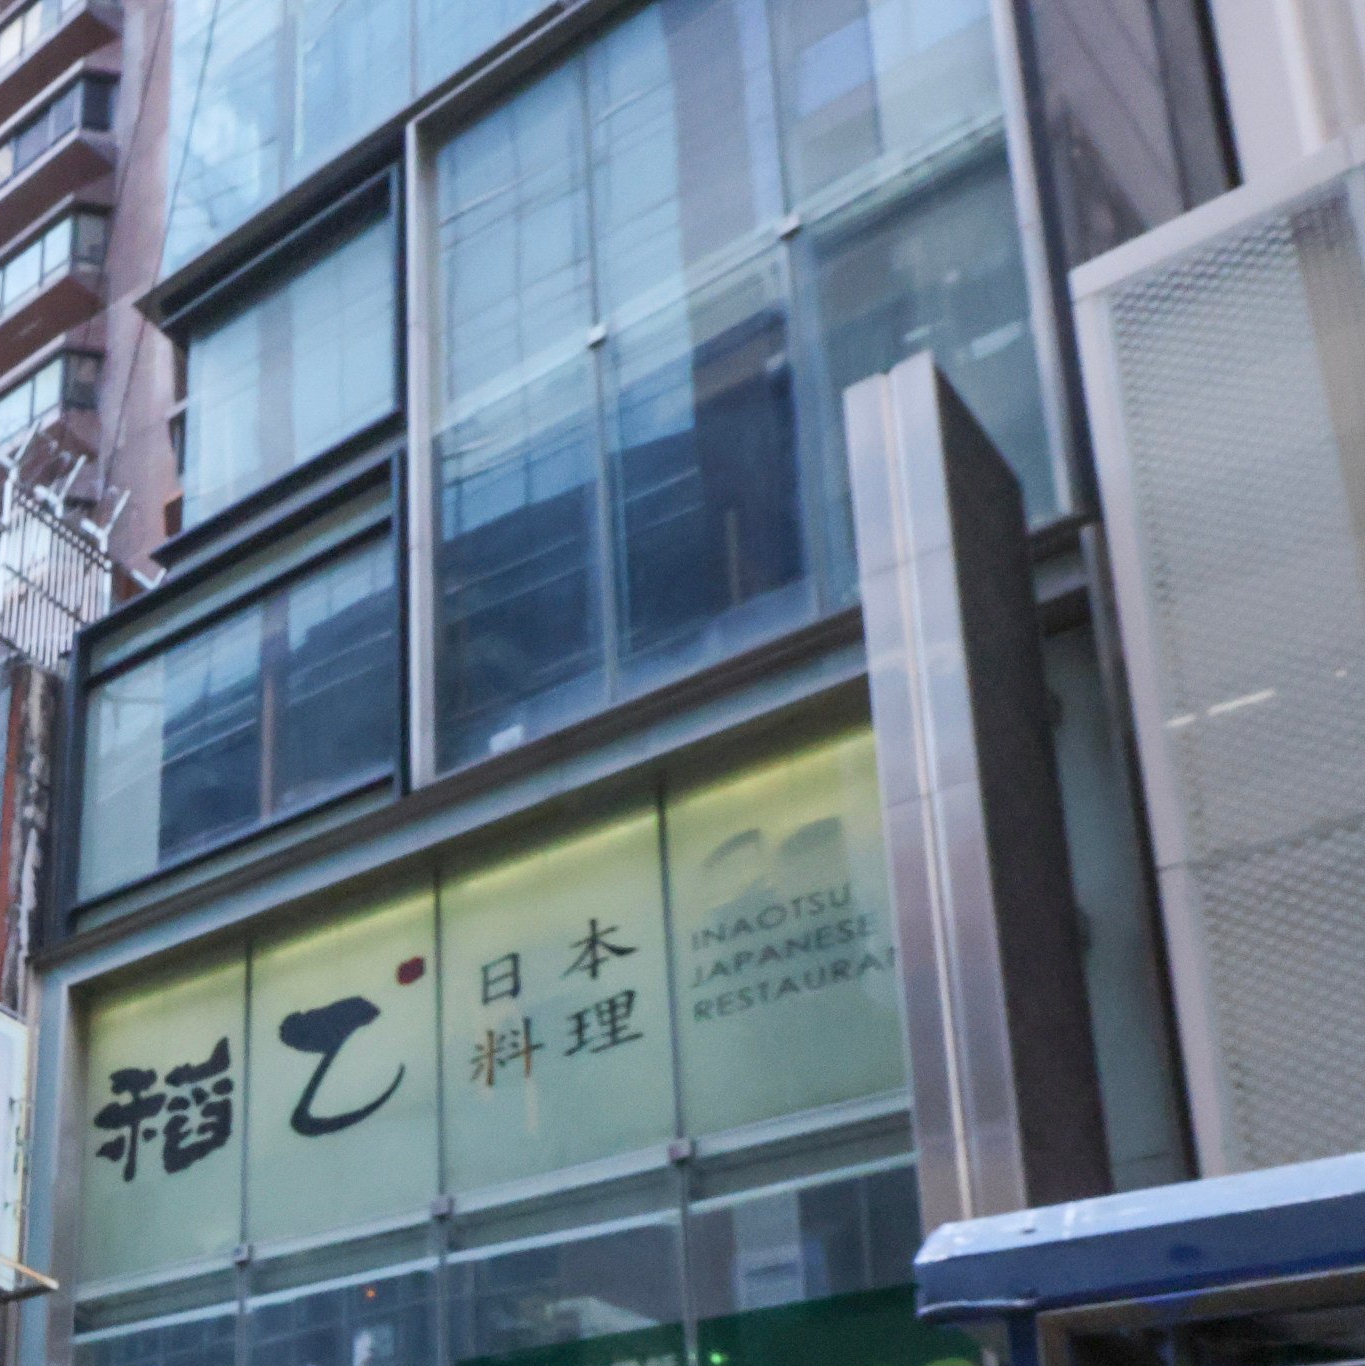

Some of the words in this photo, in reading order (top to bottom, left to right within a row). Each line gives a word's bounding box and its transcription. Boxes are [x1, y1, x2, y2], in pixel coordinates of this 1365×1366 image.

[691, 881, 852, 952] INAOTSU
[691, 911, 875, 990] JAPANESE
[480, 918, 641, 1007] 日本
[469, 987, 647, 1090] 料理
